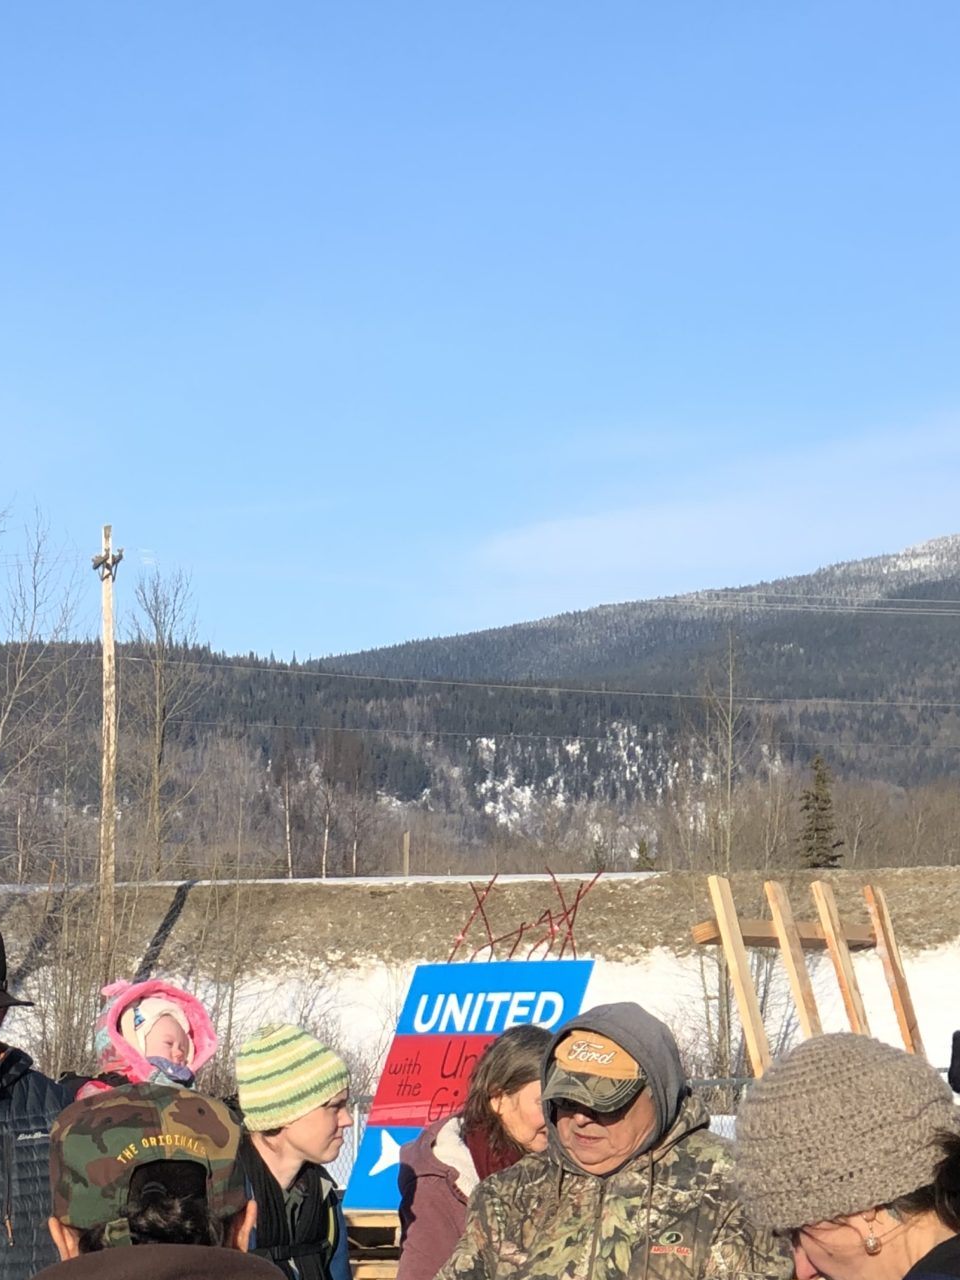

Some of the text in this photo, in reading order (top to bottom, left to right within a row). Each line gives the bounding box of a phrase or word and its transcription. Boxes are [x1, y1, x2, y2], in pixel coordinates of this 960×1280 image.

[413, 991, 565, 1033] UNITED
[388, 1050, 422, 1075] with
[440, 1039, 489, 1079] Un
[567, 1040, 617, 1065] Ford
[396, 1076, 422, 1097] the
[116, 1143, 139, 1164] THE
